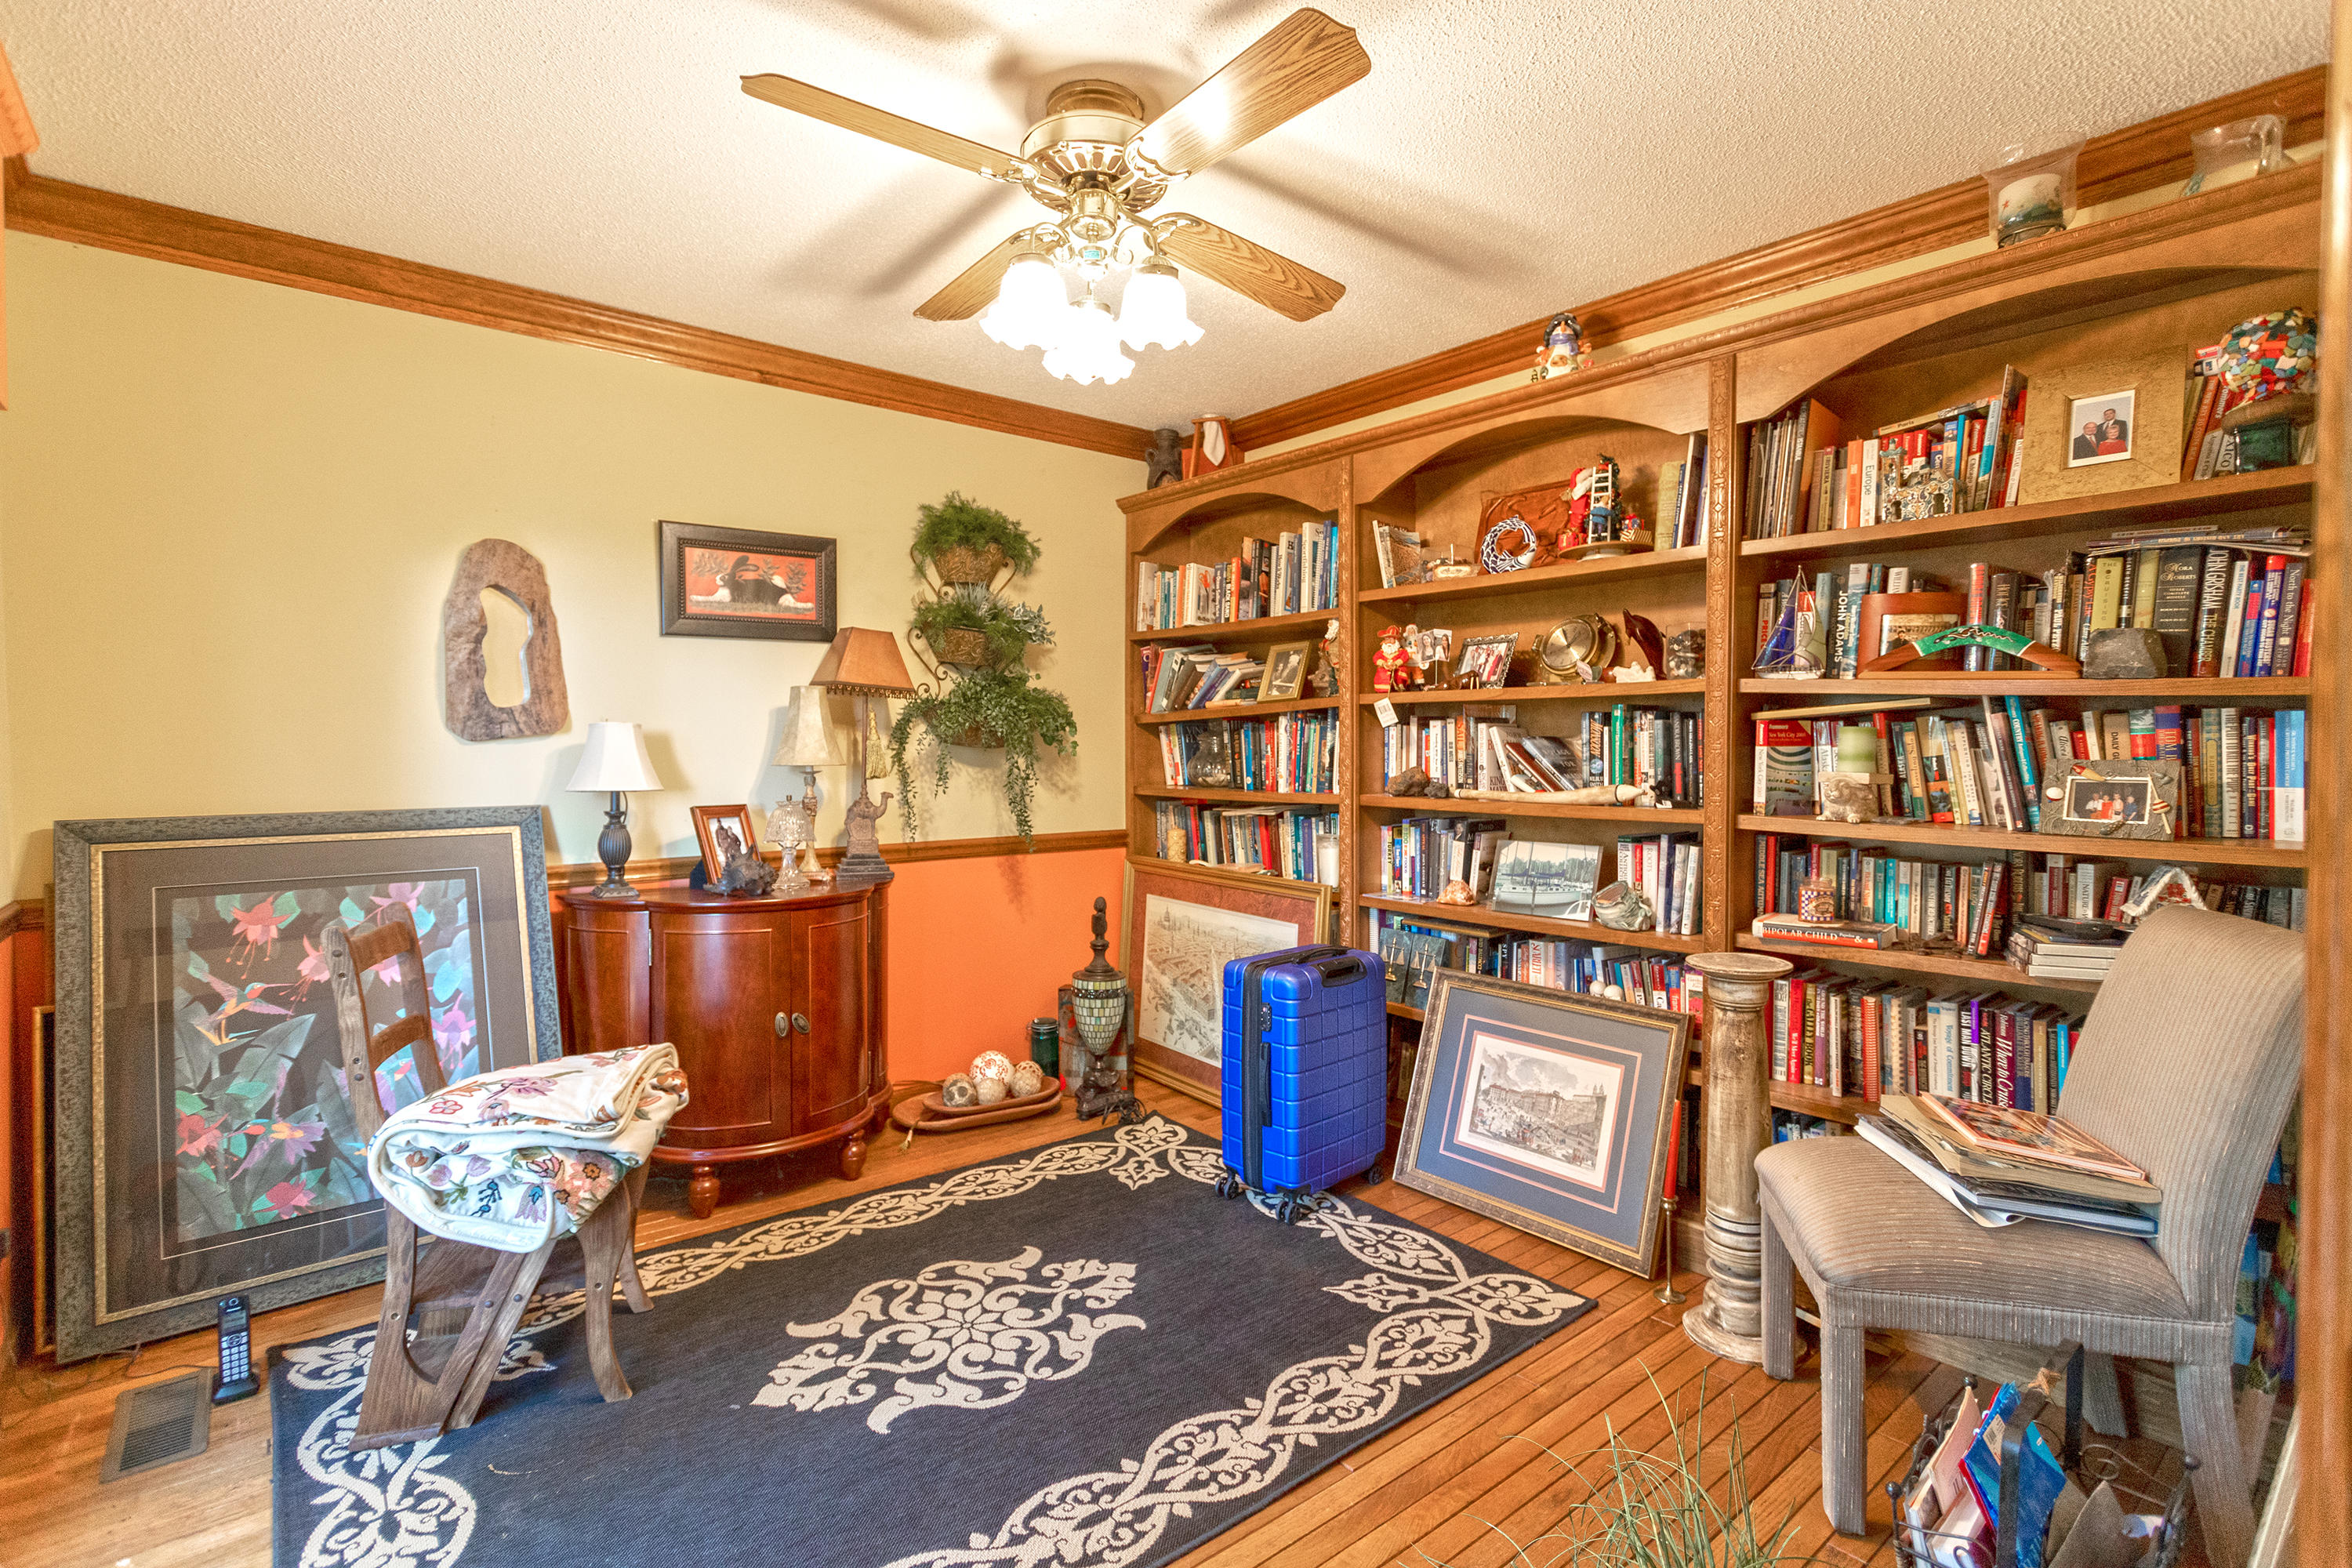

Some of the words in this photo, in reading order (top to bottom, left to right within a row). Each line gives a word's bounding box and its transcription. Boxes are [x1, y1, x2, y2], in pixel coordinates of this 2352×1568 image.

[1897, 420, 1915, 430] Paris
[1795, 437, 1804, 461] ISTANBUL
[1863, 465, 1875, 496] Europe
[1967, 458, 1977, 485] Chicago
[2089, 564, 2096, 573] A
[2207, 550, 2229, 572] JOHN
[2082, 573, 2096, 601] Gypsy
[2202, 572, 2226, 609] GRISHAM
[2287, 569, 2300, 591] North
[1837, 590, 1848, 621] JOHN
[2285, 602, 2294, 613] the
[2202, 613, 2217, 627] THE
[2266, 620, 2276, 637] SUGAR
[2281, 615, 2293, 634] Night
[1834, 623, 1845, 662] ADAMS
[2198, 629, 2216, 662] CHAMBER
[1589, 719, 1603, 758] MONSOON
[2012, 718, 2024, 742] COUNTRY
[2111, 731, 2119, 750] DAILY
[2164, 730, 2177, 748] TOM
[1961, 731, 1971, 768] EXPLORING
[2058, 736, 2070, 757] Alice's
[1898, 756, 1907, 779] ALASKA
[2225, 764, 2239, 775] THE
[2013, 851, 2024, 866] NORA
[2012, 869, 2024, 893] ROBERTS
[2082, 884, 2090, 909] NATURE
[1763, 927, 1803, 938] BIPOLAR
[1805, 931, 1838, 941] CHILD
[1531, 943, 1542, 974] SCARLETT
[1805, 1008, 1816, 1040] GALLEY
[1960, 1011, 1972, 1026] LAST
[1944, 1025, 1954, 1044] Voyage
[1960, 1028, 1972, 1044] MAN
[1805, 1042, 1815, 1067] BOOK
[1960, 1046, 1972, 1068] DOWN
[1980, 1028, 1992, 1073] ATLANTIC
[1996, 1037, 2013, 1067] Where
[1998, 1067, 2010, 1076] to
[1980, 1073, 1994, 1105] CIRCLE
